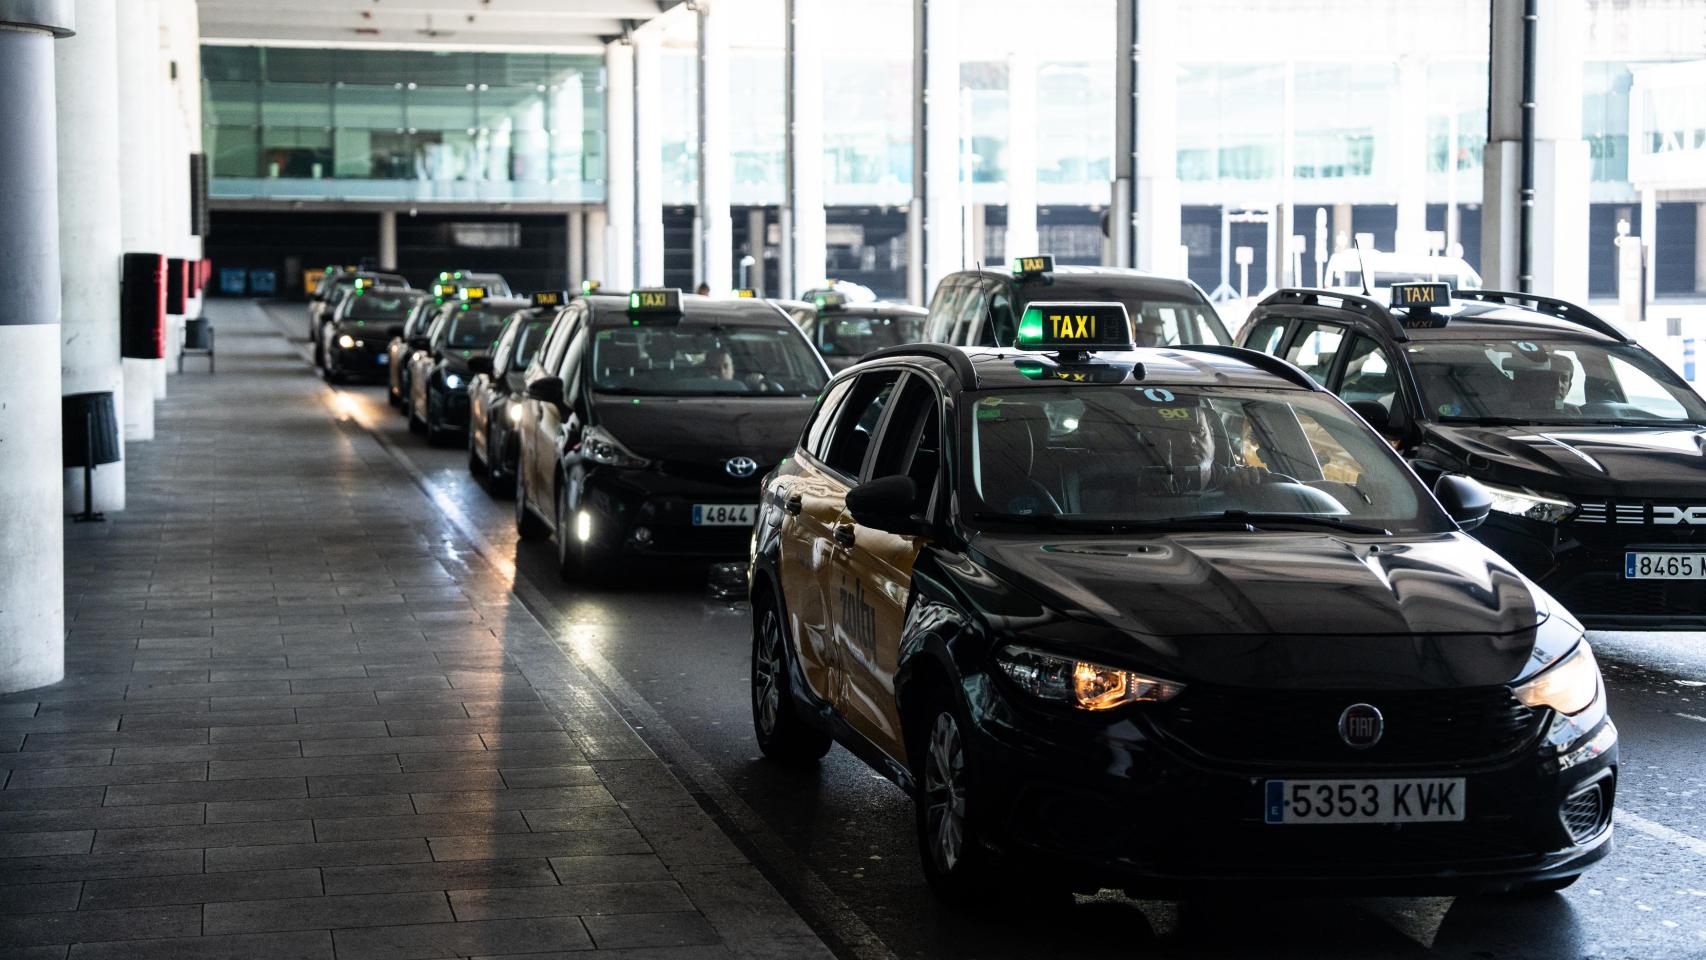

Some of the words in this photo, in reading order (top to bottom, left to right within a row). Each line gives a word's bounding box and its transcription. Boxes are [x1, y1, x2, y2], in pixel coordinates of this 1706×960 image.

[1023, 258, 1044, 271] TAXI
[641, 293, 666, 306] TAXI
[1404, 287, 1435, 303] TAXI
[1049, 315, 1096, 339] TAXI
[706, 507, 748, 523] 4844
[1640, 557, 1693, 576] 8465
[1349, 716, 1375, 737] FIAT
[1292, 784, 1380, 818] 5353
[1393, 782, 1457, 817] KVK
